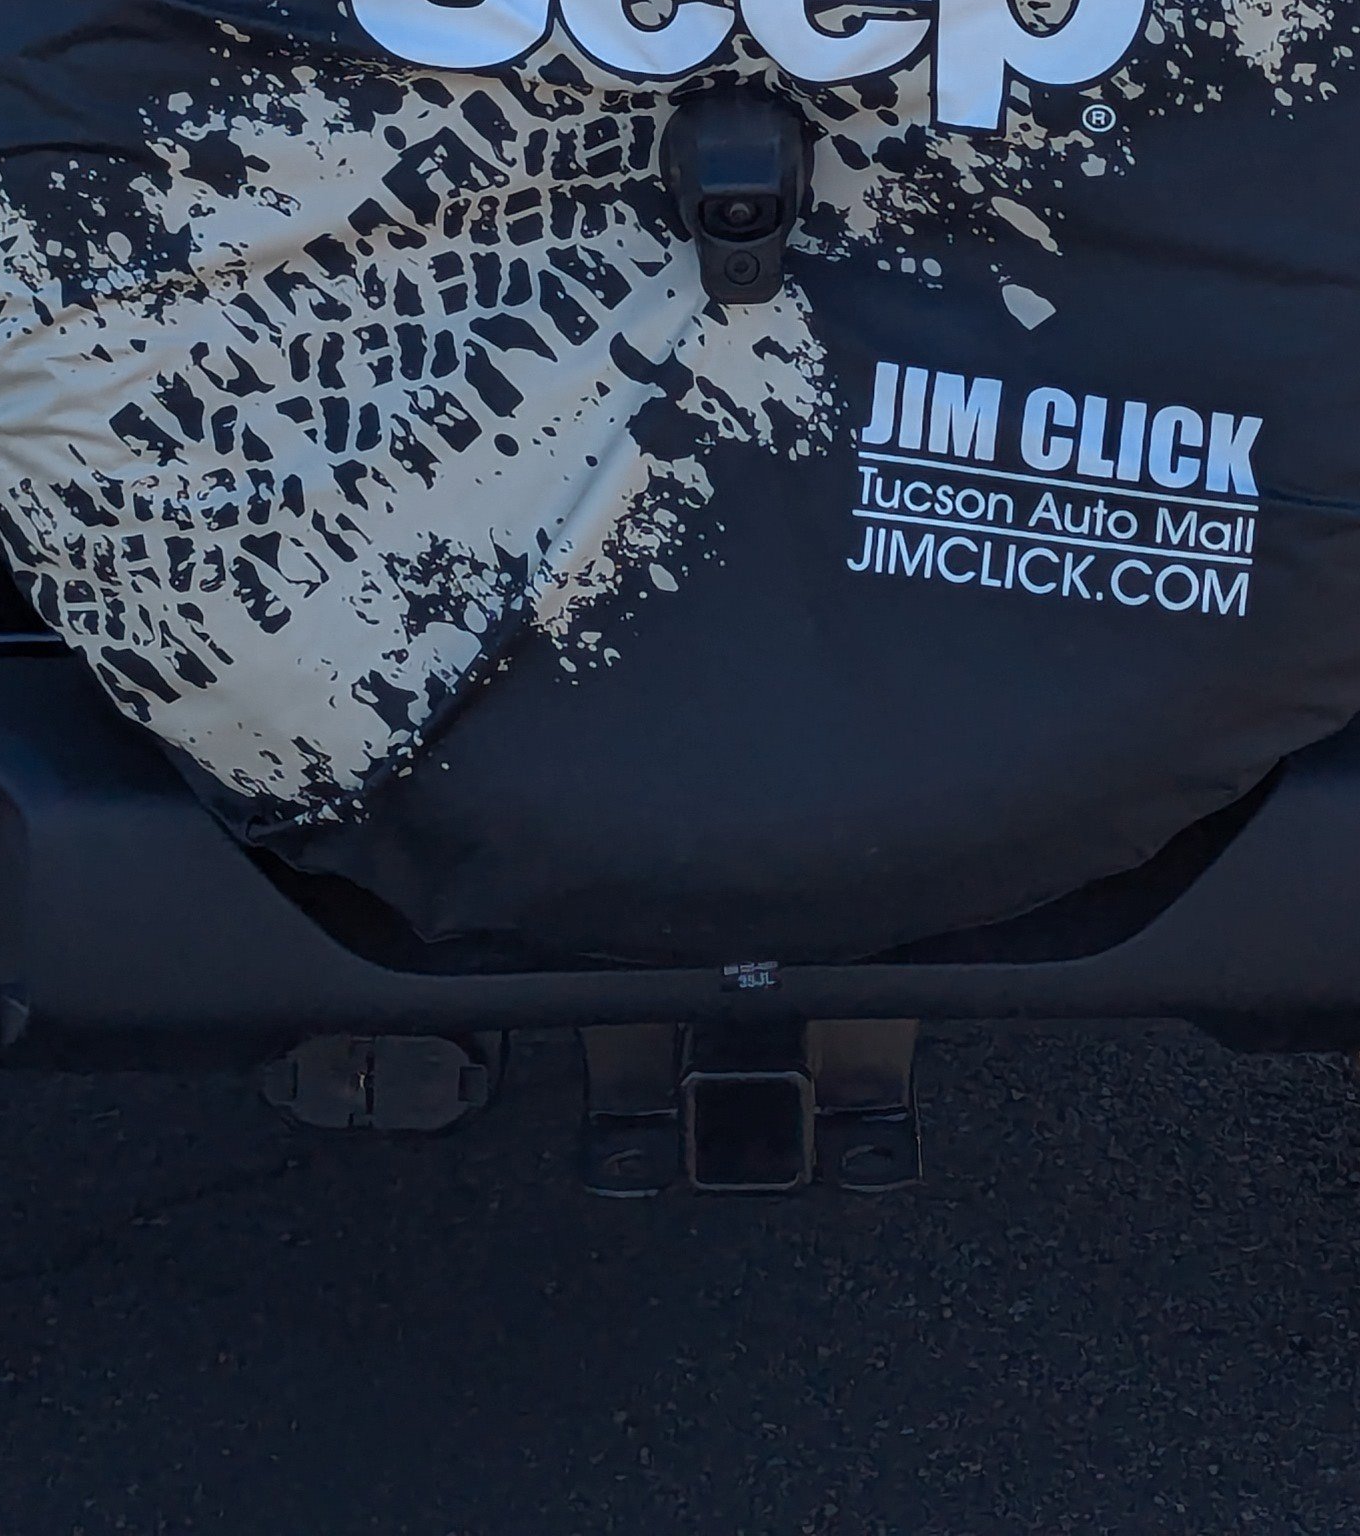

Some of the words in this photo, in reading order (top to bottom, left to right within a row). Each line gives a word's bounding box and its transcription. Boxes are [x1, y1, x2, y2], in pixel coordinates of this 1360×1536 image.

[861, 361, 1003, 462] JIM
[1020, 386, 1263, 497] CLICK
[857, 466, 1014, 524] Tucson
[1028, 492, 1138, 540] Auto
[1155, 508, 1256, 554] Mall
[846, 526, 1250, 618] JIMCLICK.COM
